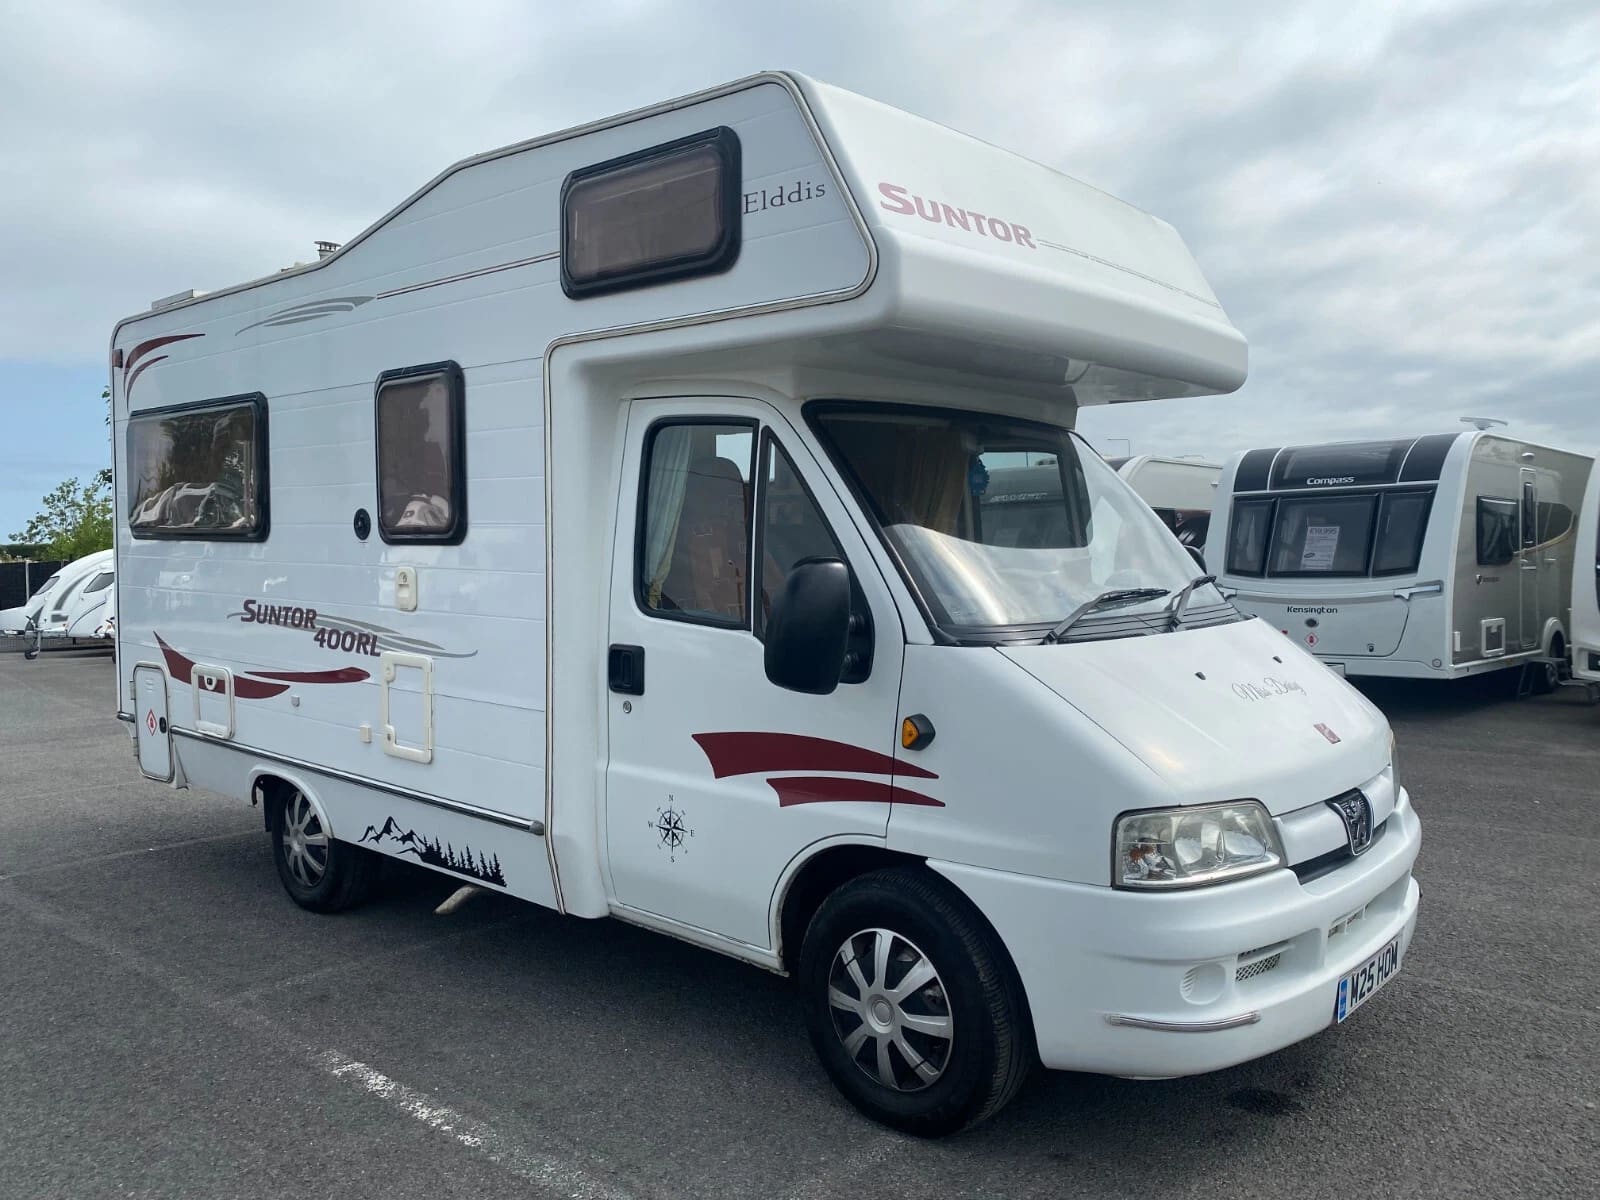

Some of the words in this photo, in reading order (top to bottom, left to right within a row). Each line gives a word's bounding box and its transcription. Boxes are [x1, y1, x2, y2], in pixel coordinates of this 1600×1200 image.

[742, 181, 826, 215] Elddis
[877, 181, 1037, 249] SUNTOR
[1306, 476, 1355, 486] Compass
[240, 599, 317, 629] SUNTOR
[1286, 605, 1338, 615] Kensington
[313, 627, 381, 656] 400RL
[1350, 960, 1375, 1007] M25
[1376, 941, 1398, 985] HOM
